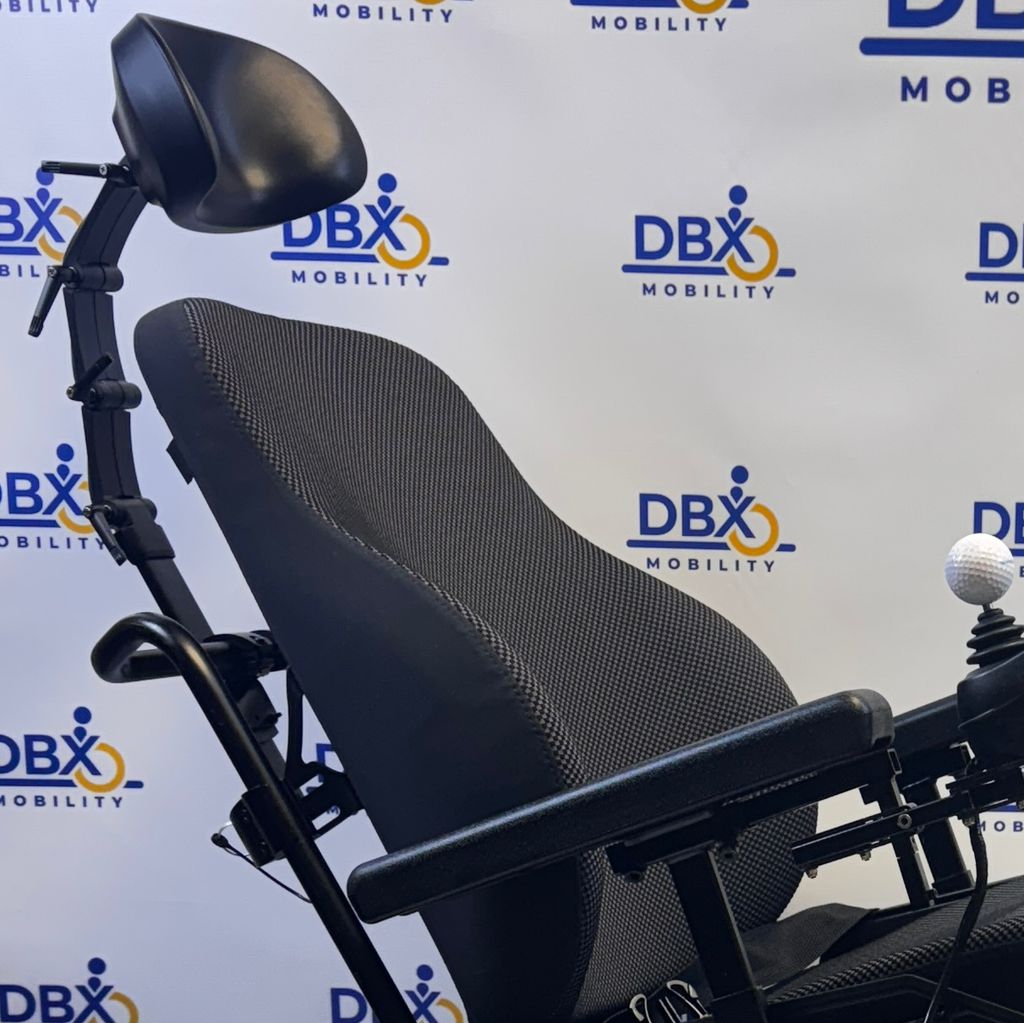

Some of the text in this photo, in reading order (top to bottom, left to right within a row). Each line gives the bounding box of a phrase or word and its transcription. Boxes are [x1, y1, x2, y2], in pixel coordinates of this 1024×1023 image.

[0, 0, 98, 13] BILITY
[313, 4, 452, 23] MOBILITY
[592, 16, 726, 31] MOBILITY
[281, 203, 406, 251] DBX
[635, 215, 754, 263] DBX
[292, 270, 426, 286] MOBILITY
[643, 283, 774, 298] MOBILITY
[0, 472, 86, 516] BX
[639, 493, 755, 538] DBX
[647, 558, 774, 572] MOBILITY
